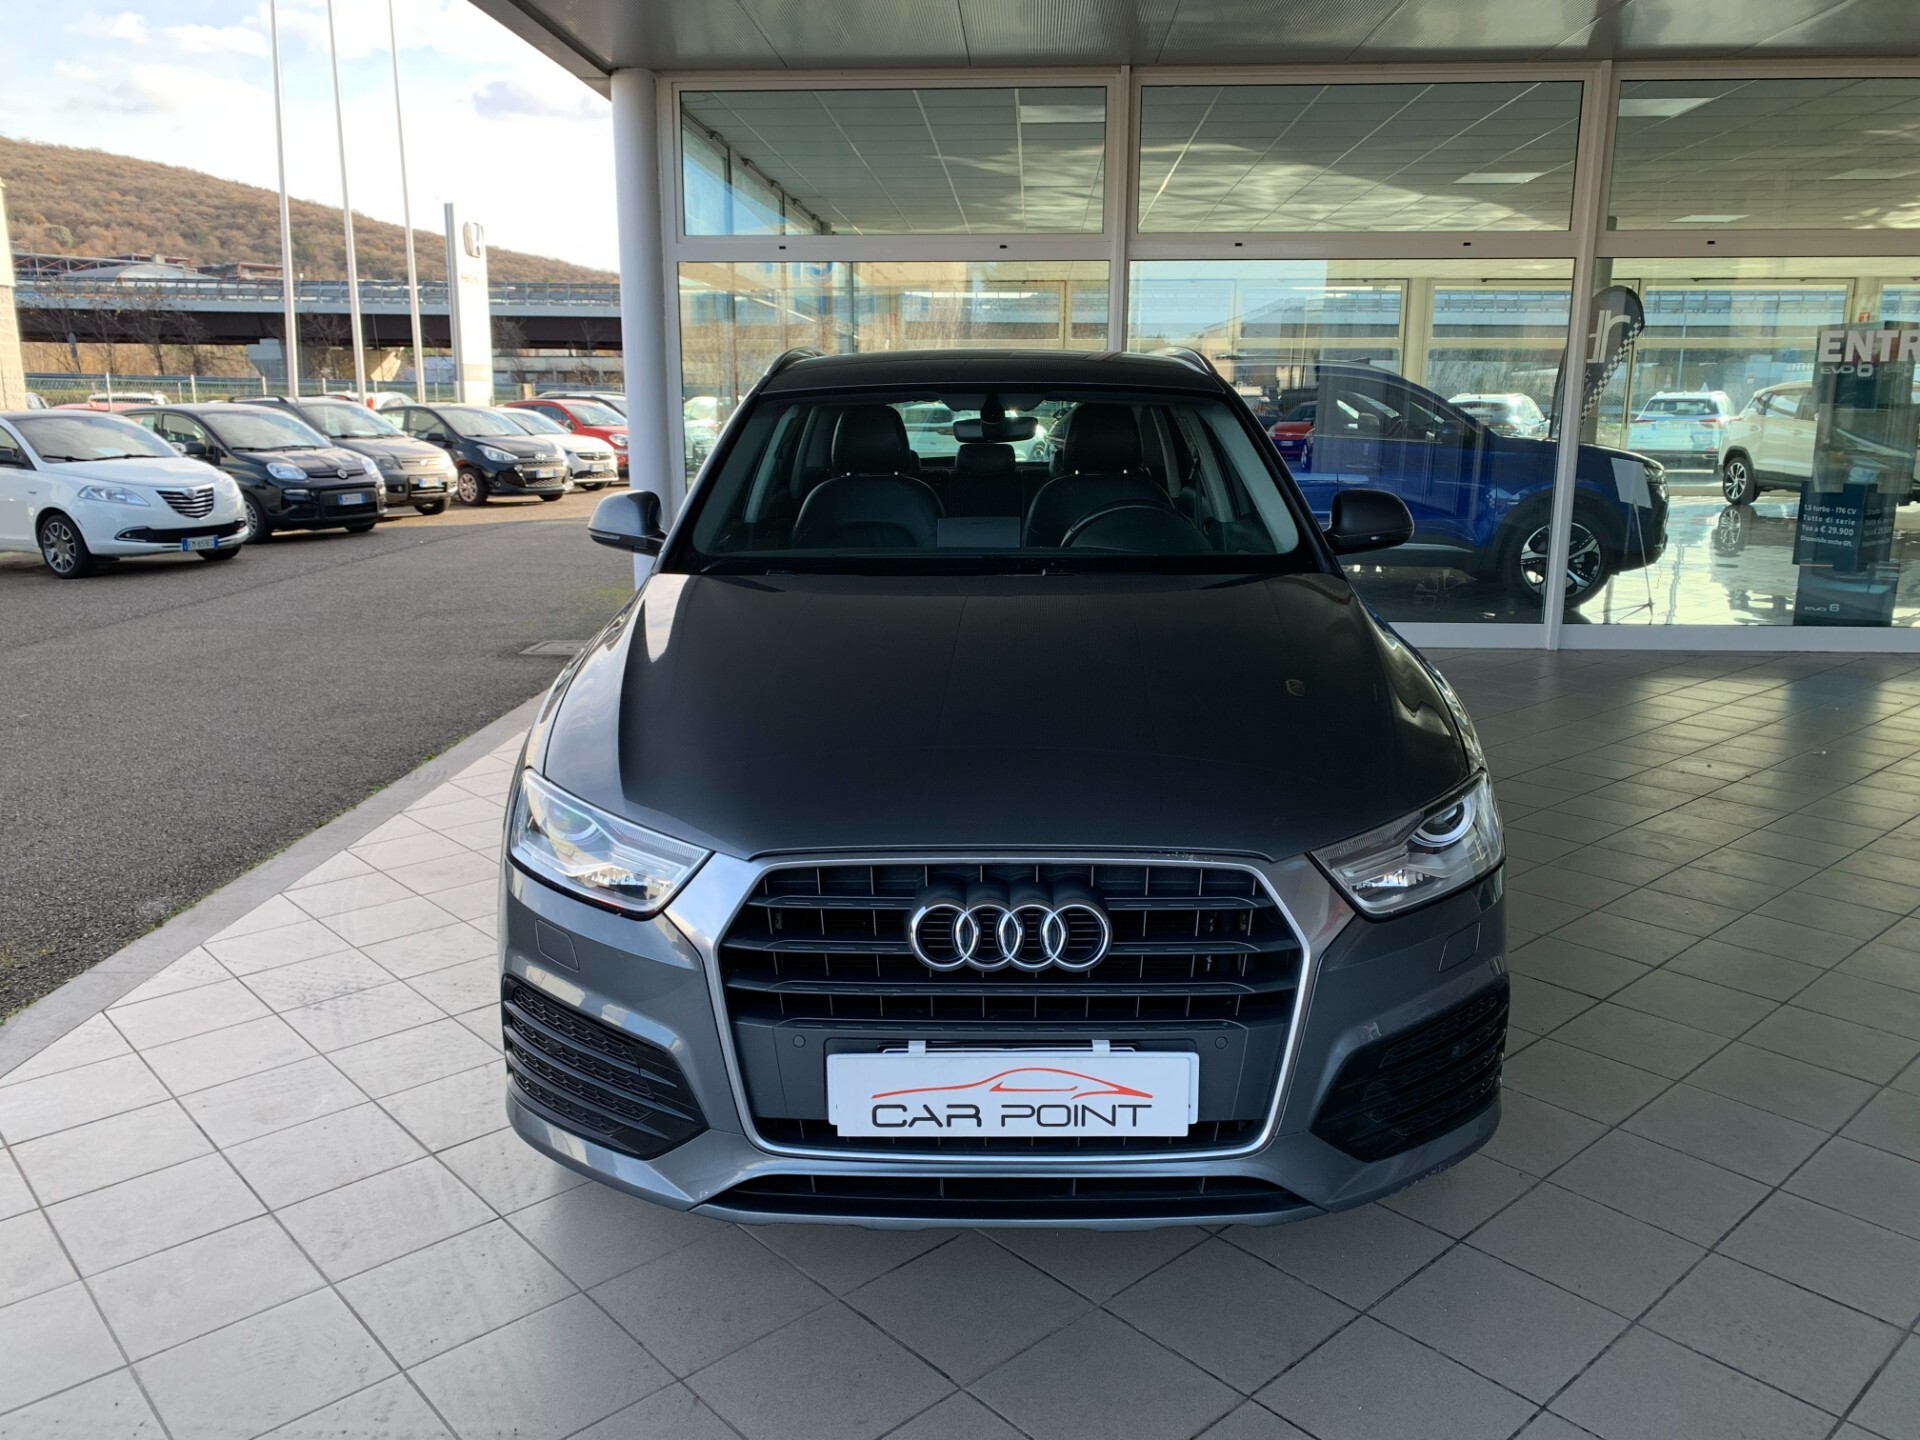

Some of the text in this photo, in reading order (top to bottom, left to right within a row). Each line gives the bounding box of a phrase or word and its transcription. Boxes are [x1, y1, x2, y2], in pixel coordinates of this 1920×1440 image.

[1820, 364, 1856, 375] EVO
[1813, 504, 1831, 513] turbo
[1803, 513, 1823, 522] Tutto
[1835, 518, 1856, 526] serie
[1801, 524, 1813, 532] Tua
[1827, 526, 1854, 536] 29.900
[1829, 603, 1840, 612] 6
[871, 1103, 1153, 1128] CAR POINT
